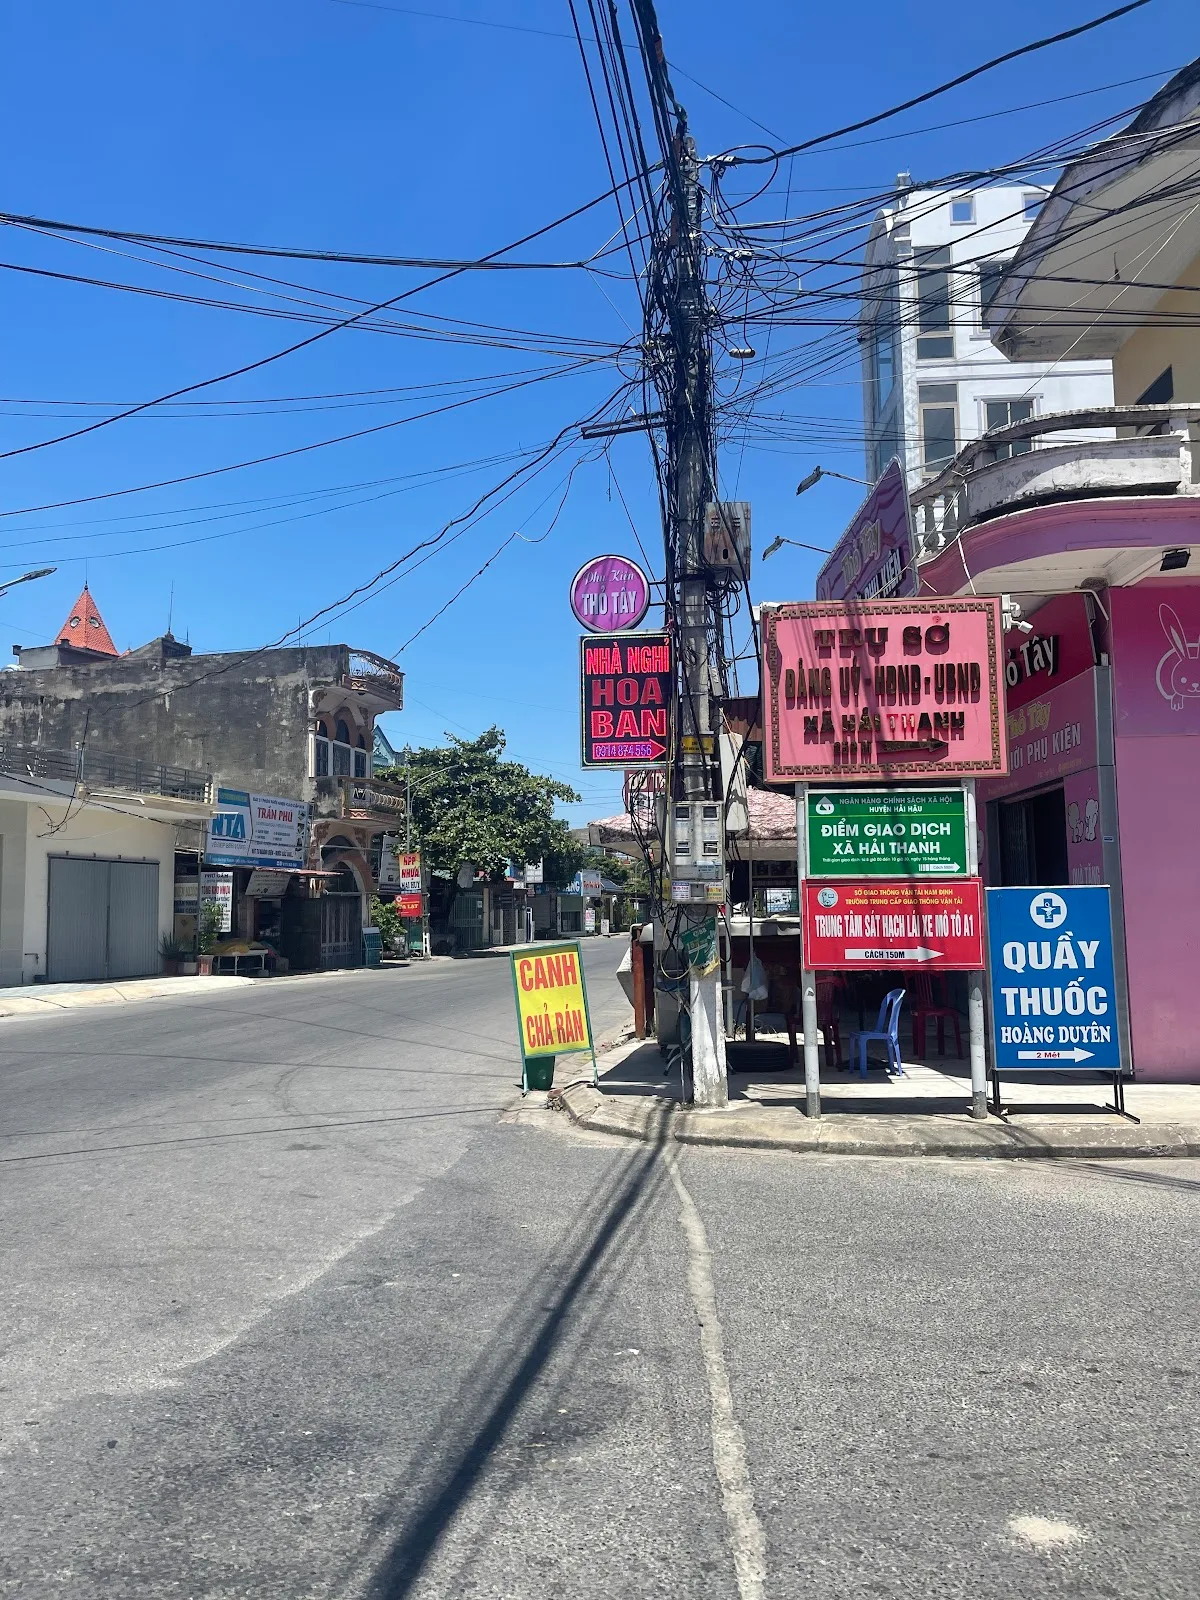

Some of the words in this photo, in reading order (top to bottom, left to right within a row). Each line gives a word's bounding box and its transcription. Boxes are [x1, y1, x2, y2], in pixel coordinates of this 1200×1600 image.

[582, 585, 608, 616] THỎ
[611, 587, 637, 614] TÂY
[586, 641, 622, 675] NHÀ
[627, 638, 670, 673] NGHỈ
[1020, 635, 1053, 677] Tây
[592, 678, 664, 706] HOA
[934, 662, 981, 701] UBND
[591, 709, 667, 738] BAN
[803, 711, 835, 740] XÃ
[886, 711, 965, 738] THANH
[1010, 745, 1024, 771] IỚI
[1027, 736, 1048, 765] PHỤ
[1052, 722, 1080, 755] KIỆN
[839, 797, 859, 805] NGÂN
[861, 796, 881, 804] HÀNG
[884, 796, 905, 804] CHÍNH
[940, 795, 953, 804] HỘI
[869, 805, 892, 814] HUYỆN
[894, 804, 906, 812] HẢI
[908, 805, 923, 813] HẬU
[212, 814, 246, 839] NTA
[821, 818, 859, 837] ĐIỂM
[863, 823, 906, 837] GIAO
[911, 822, 951, 839] DỊCH
[833, 840, 855, 855] XÃ
[859, 838, 885, 855] HẢI
[889, 842, 940, 855] THANH
[845, 897, 868, 905] TRƯỜNG
[890, 896, 902, 905] CẤP
[919, 897, 939, 905] THÔNG
[941, 896, 953, 906] VẬN
[954, 896, 963, 904] TẢI
[854, 888, 862, 896] SỞ
[880, 888, 899, 896] THÔNG
[900, 888, 913, 897] VẬN
[939, 889, 953, 897] ĐỊNH
[815, 915, 842, 938] TRUNG
[844, 911, 862, 938] TÂM
[865, 909, 880, 937] SÁT
[883, 914, 905, 942] HẠCH
[907, 910, 920, 937] LÁI
[922, 914, 933, 937] XE
[936, 911, 949, 937] MÔ
[951, 910, 961, 937] TÔ
[964, 914, 974, 937] A1
[864, 949, 884, 959] CÁCH
[886, 951, 905, 959] 150M
[1003, 931, 1100, 973] QUẦY
[519, 953, 578, 992] CANH
[1001, 976, 1107, 1016] THUỐC
[526, 1002, 555, 1048] CHẢ
[555, 1003, 584, 1044] RÁN
[1001, 1022, 1054, 1044] HOÀNG
[1058, 1021, 1111, 1043] DUYÊN
